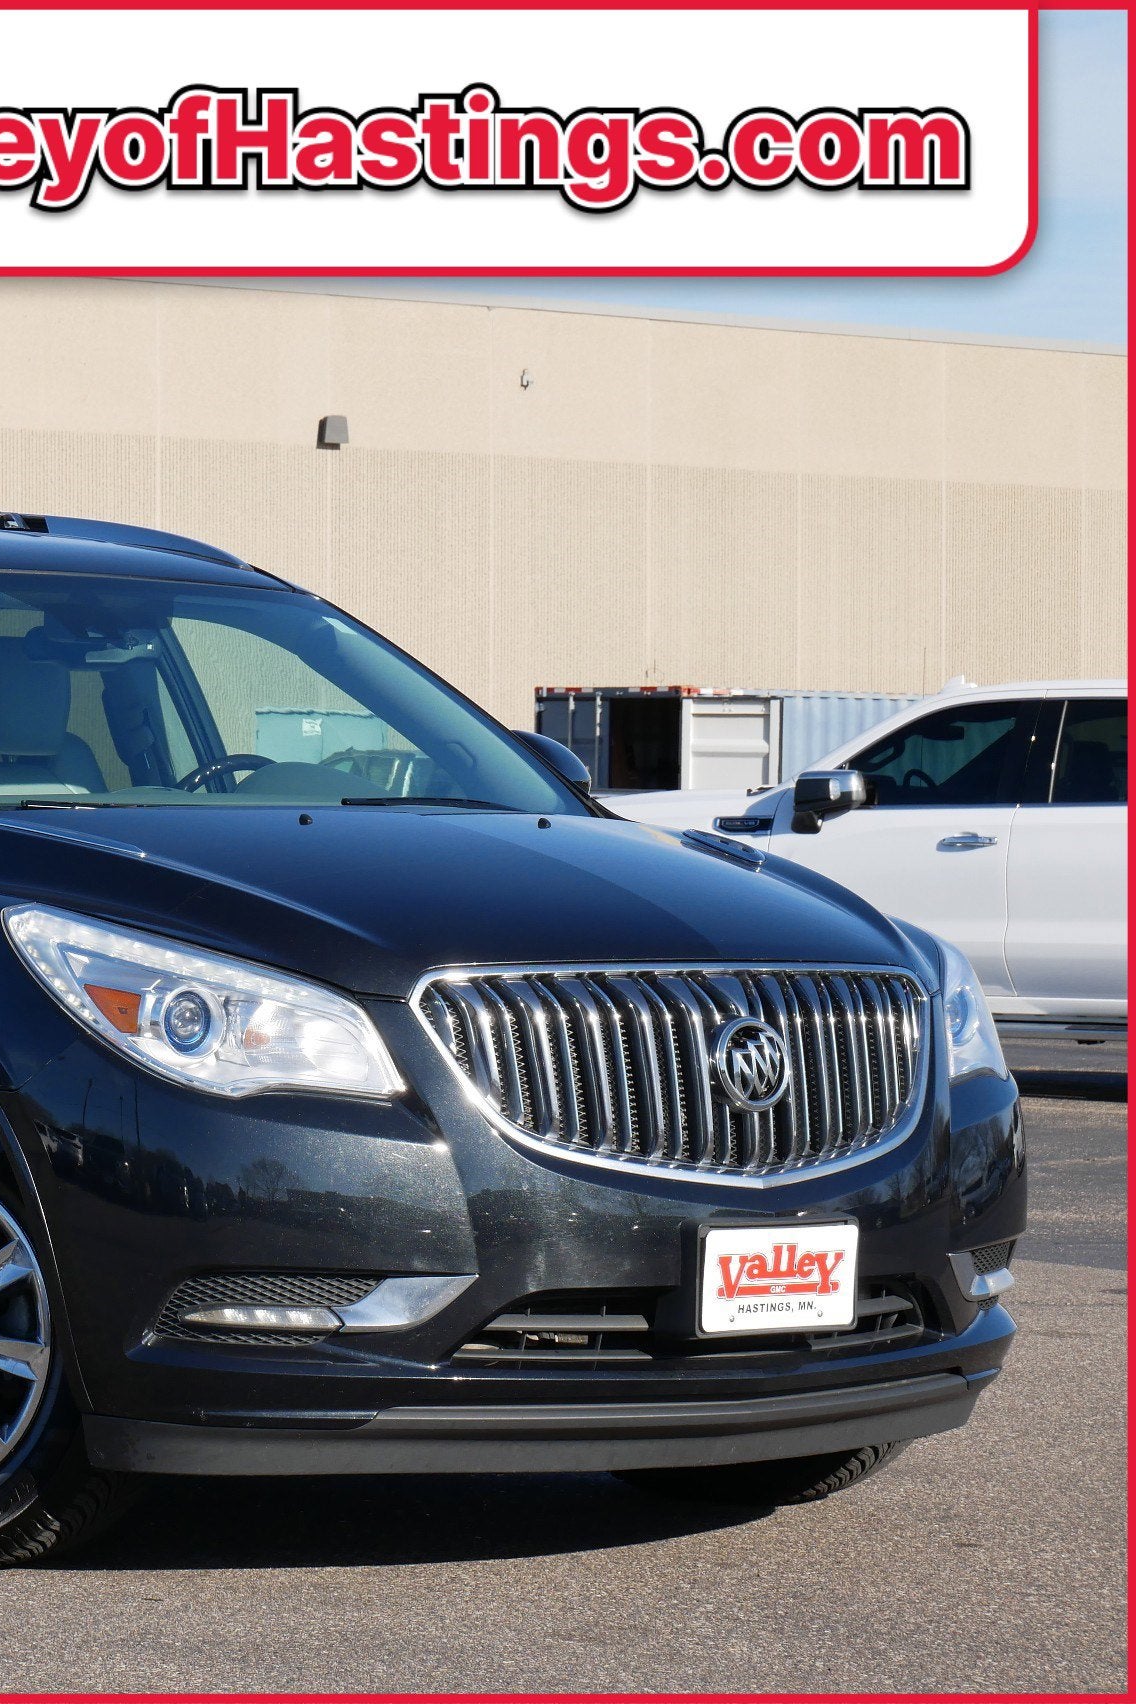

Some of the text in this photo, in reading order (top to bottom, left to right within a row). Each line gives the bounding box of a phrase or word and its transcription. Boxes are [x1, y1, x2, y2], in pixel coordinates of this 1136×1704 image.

[718, 1243, 845, 1300] Valley
[769, 1285, 787, 1294] GMC
[737, 1300, 817, 1314] HASTINGS, MN.
